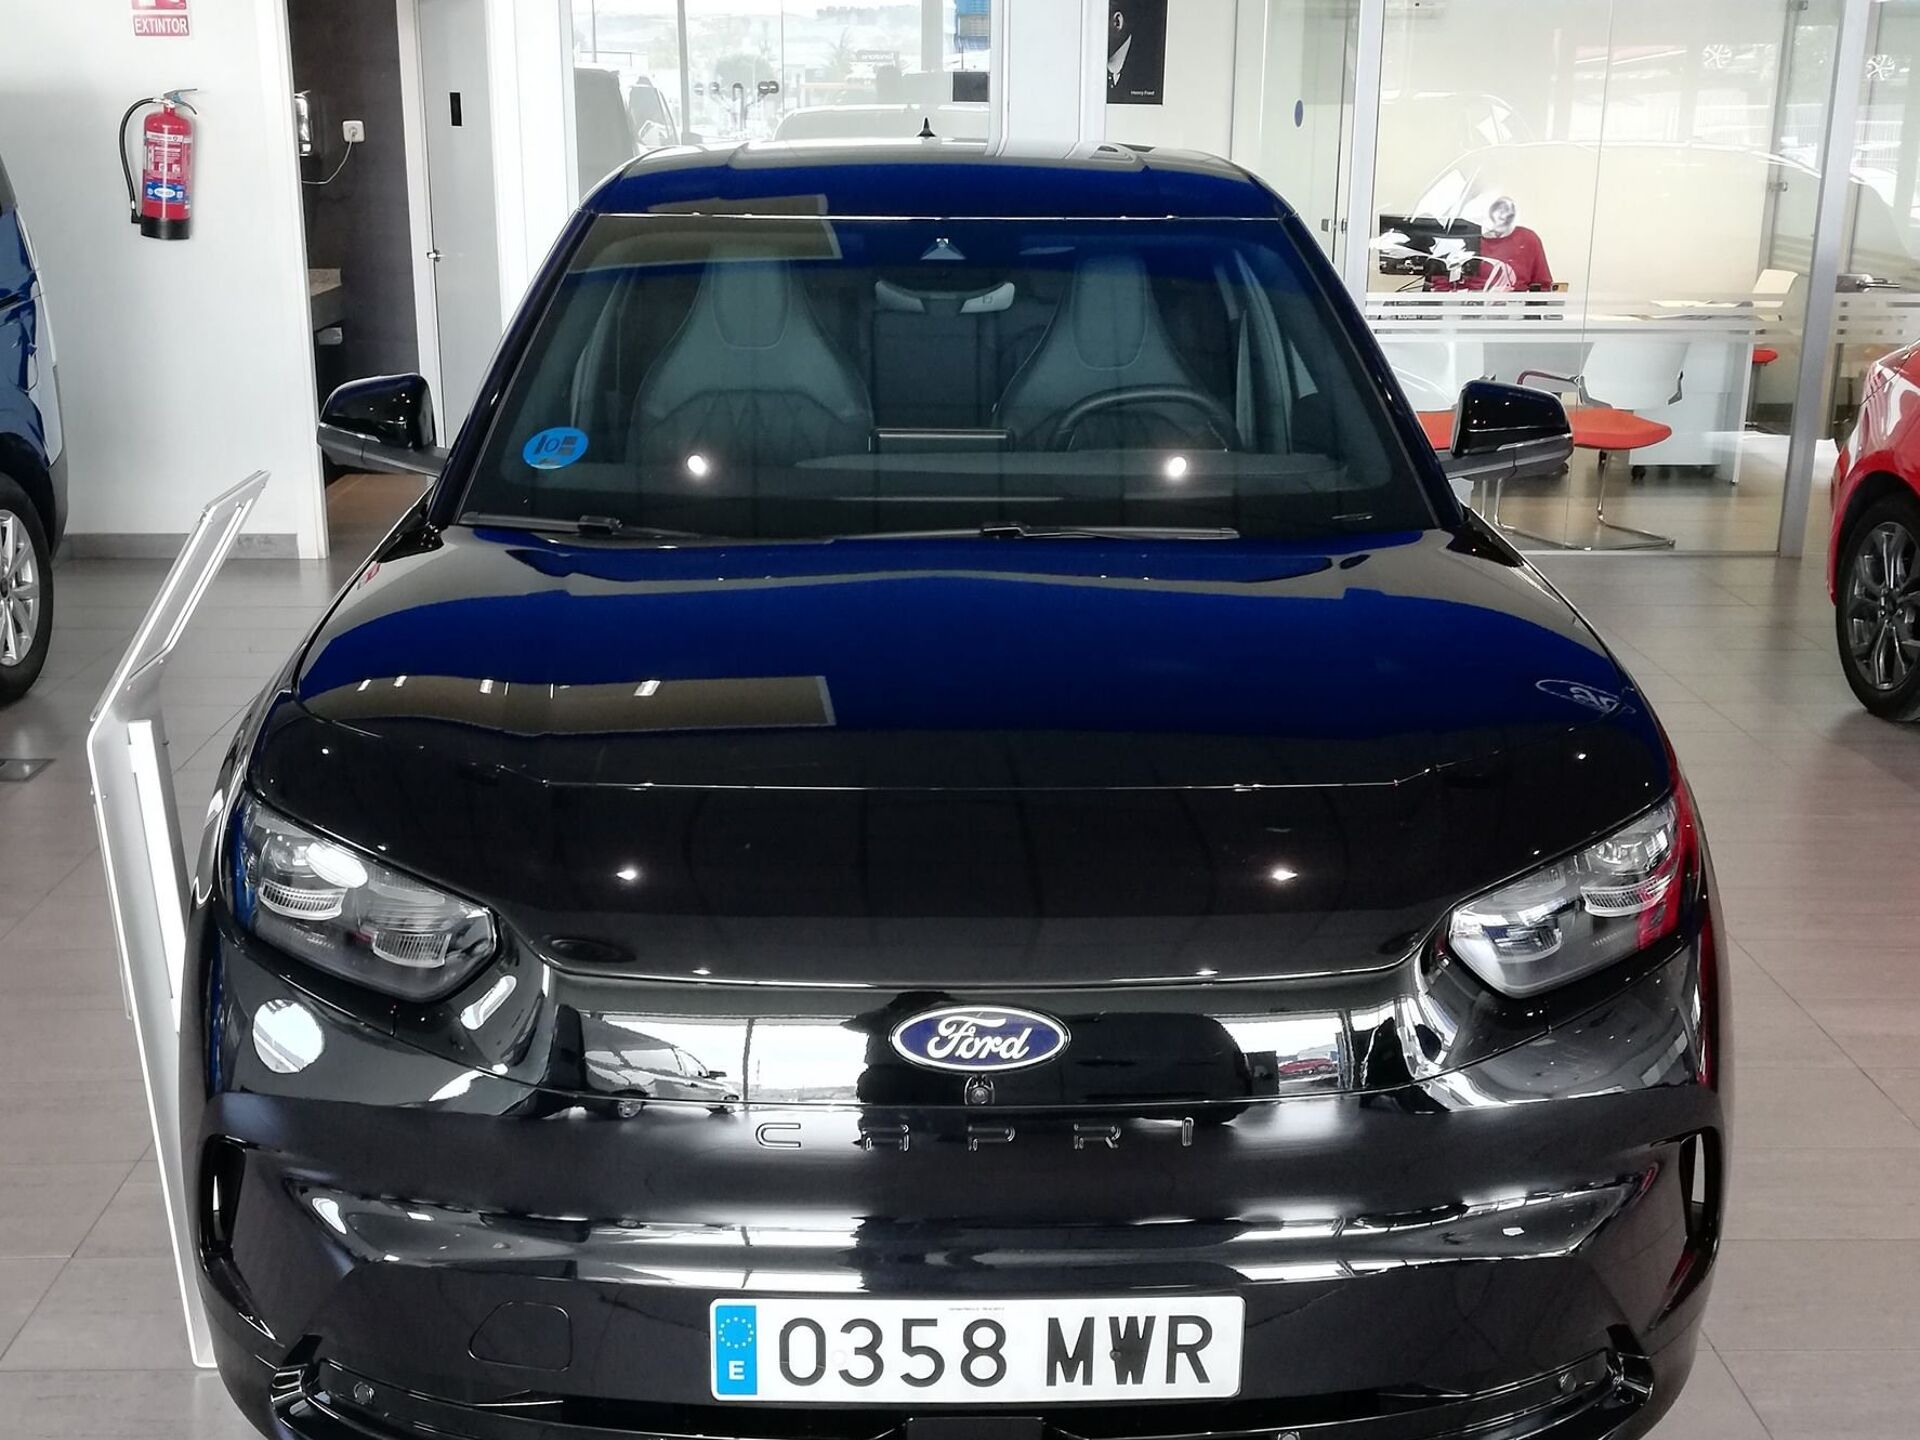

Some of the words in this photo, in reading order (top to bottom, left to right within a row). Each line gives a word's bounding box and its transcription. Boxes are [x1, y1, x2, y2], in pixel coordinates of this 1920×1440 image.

[135, 17, 188, 34] EXTINTOR
[927, 1015, 1032, 1060] Ford
[755, 1116, 1195, 1150] CAPRI
[779, 1317, 1007, 1388] 0358
[1046, 1315, 1213, 1387] MWR
[728, 1360, 745, 1380] E
